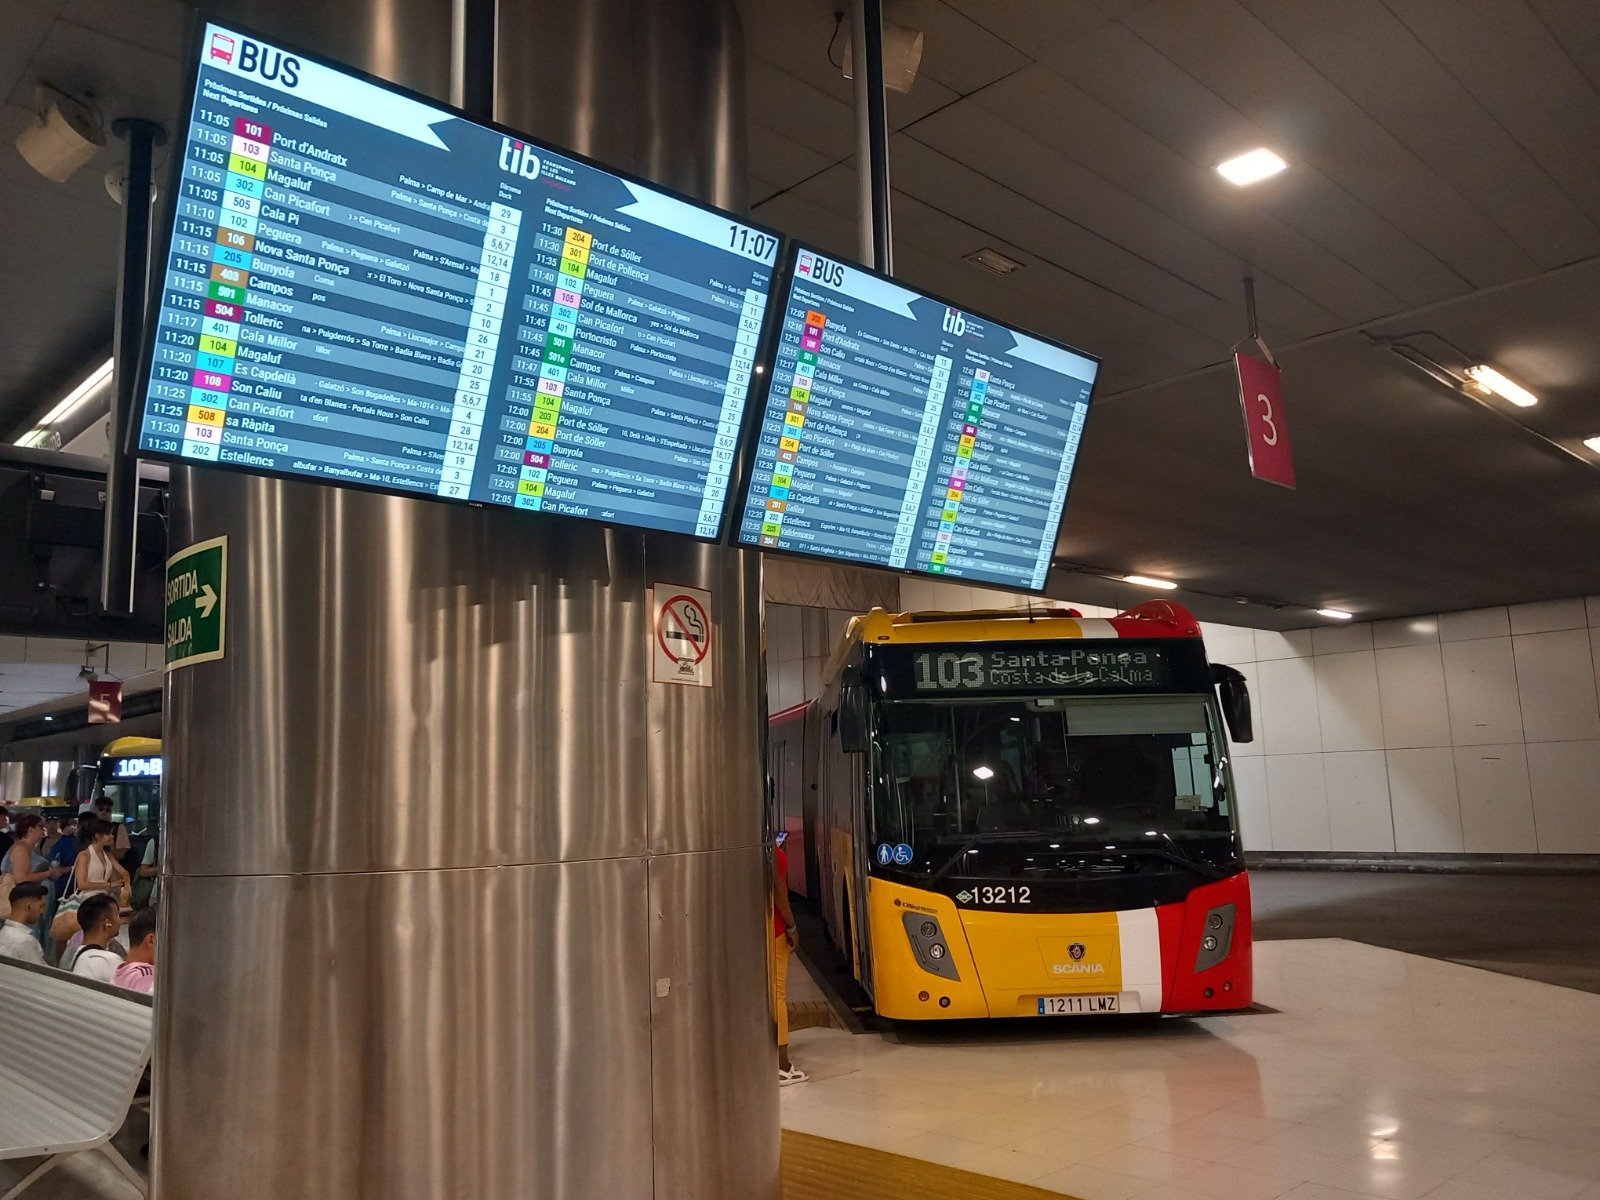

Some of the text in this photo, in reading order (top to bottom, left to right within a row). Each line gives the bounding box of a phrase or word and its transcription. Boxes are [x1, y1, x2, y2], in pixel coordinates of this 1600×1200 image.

[238, 40, 299, 87] BUS
[202, 88, 258, 113] Next Departures
[237, 90, 266, 106] Sortides
[303, 113, 327, 127] Salidas
[194, 146, 312, 191] 11:05 104 Magaluf
[197, 128, 336, 181] 11:05 103 Santa Ponça
[200, 109, 511, 218] 11:05 101 Port d'Andratx Palma Camp de Mar 29
[499, 137, 540, 179] tib
[498, 190, 512, 200] Dock
[185, 202, 302, 244] 11:10 102 Peguera
[188, 184, 499, 281] 11:05 505 Cala Pi 18
[191, 165, 507, 267] 11:05 302 Can Picafort 12,14
[179, 239, 294, 278] 11:15 205 Bunyola
[182, 221, 349, 275] 11:15 106 Nova Santa Ponça
[542, 222, 562, 236] 11:30
[572, 232, 584, 242] 204
[591, 238, 608, 252] Port
[609, 244, 619, 255] de
[620, 248, 642, 263] Sóller
[730, 225, 776, 259] 11:07
[539, 238, 757, 315] 11:30 301 Port de Pollença 11
[812, 257, 844, 287] BUS
[170, 294, 283, 329] 11:15 504 Tolleric
[173, 276, 293, 313] 11:15 501 Manacor
[176, 258, 206, 274] 11:15
[249, 275, 293, 296] Campos
[477, 333, 487, 343] 26
[531, 284, 637, 322] 11:45 105 Sol de Mallorca
[168, 312, 297, 350] 11:17 401 Cala Millor
[942, 307, 965, 336] tib
[162, 348, 296, 384] 11:20 107 Es Capdellà
[525, 314, 743, 381] 11:45 401 Portocristo 25
[159, 366, 282, 399] 11:20 108 Son Caliu
[165, 330, 481, 406] 11:20 104 Magaluf 5,6,7
[156, 384, 294, 419] 11:25 302 Can Picafort
[1257, 393, 1278, 446] 3
[147, 437, 274, 466] 11:30 202 Estellencs
[150, 420, 288, 454] 11:30 103 Santa Ponça
[153, 402, 464, 465] 11:25 508 sa Ràpita 19
[491, 493, 715, 535] 12:05 302 Can Picafort 12,14
[167, 569, 199, 606] SORTIDA
[167, 616, 193, 649] SALIDA
[916, 652, 985, 689] 103
[991, 652, 1064, 667] Santa
[990, 668, 1044, 685] Costa
[1099, 666, 1153, 684] Calma
[970, 886, 1031, 904] 13212
[1053, 963, 1104, 974] SCANIA
[1049, 997, 1116, 1013] 1211 LMZ
